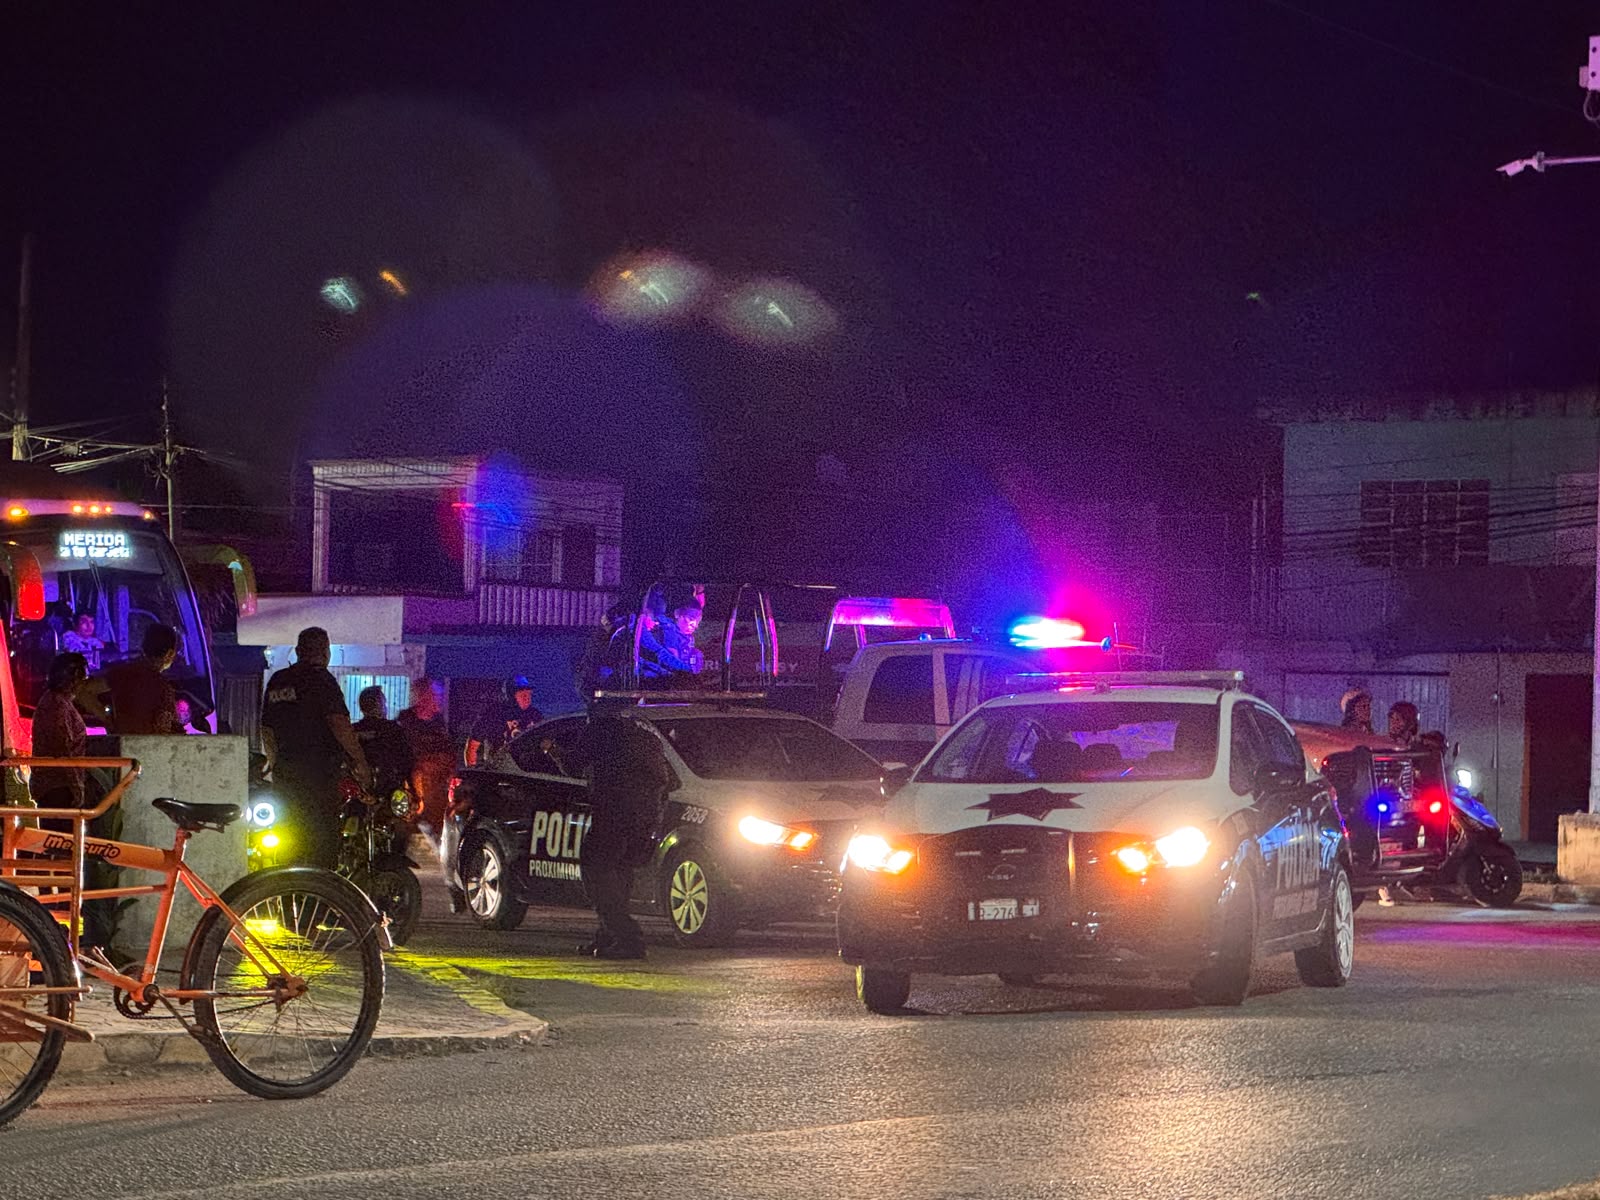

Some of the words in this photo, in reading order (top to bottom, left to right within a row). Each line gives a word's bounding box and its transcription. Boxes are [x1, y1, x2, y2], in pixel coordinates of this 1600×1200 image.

[64, 533, 125, 546] MERIDA
[530, 810, 593, 859] POLI
[529, 859, 583, 881] PROXIMIDA
